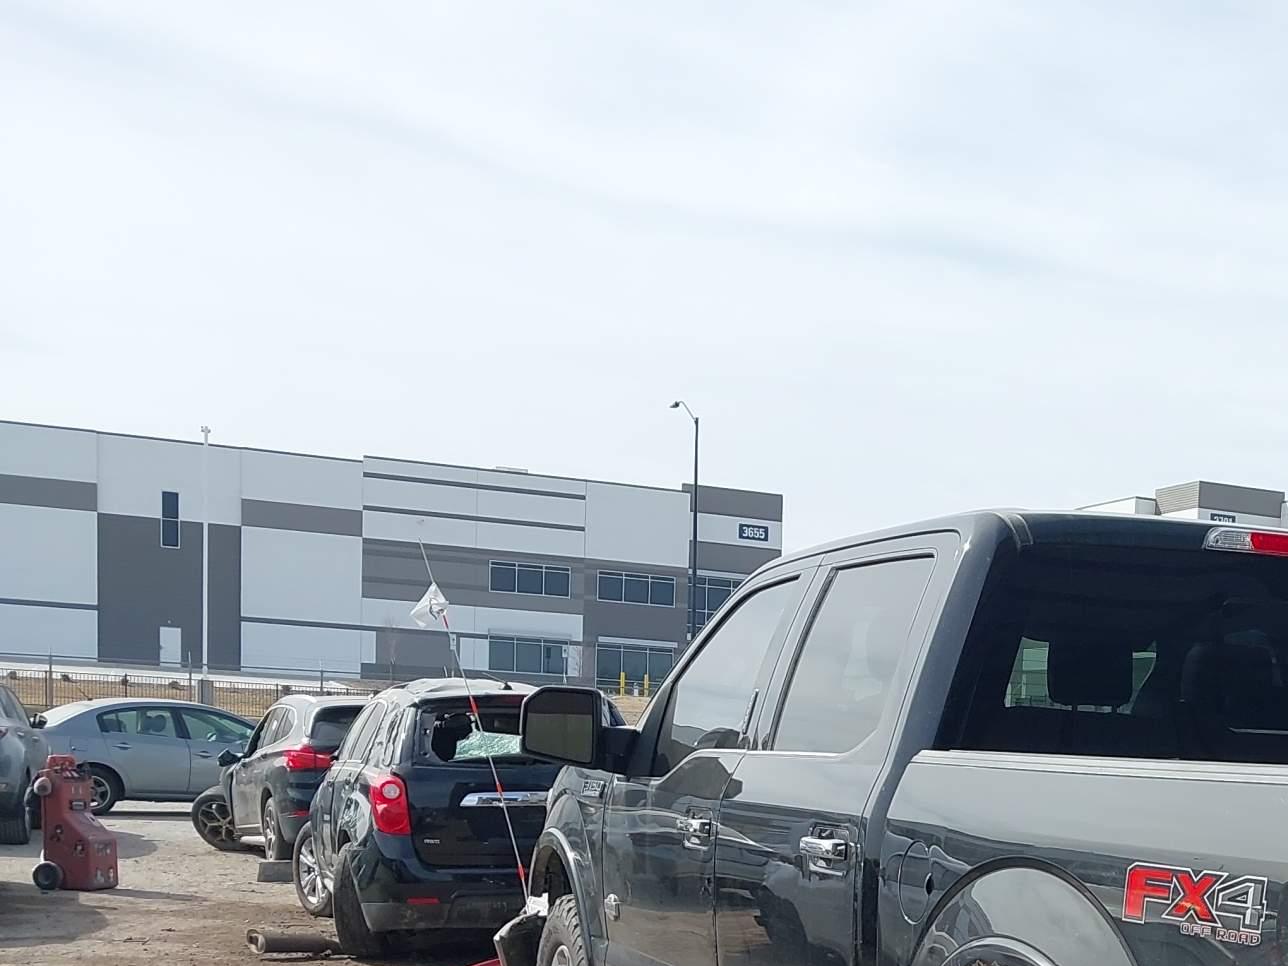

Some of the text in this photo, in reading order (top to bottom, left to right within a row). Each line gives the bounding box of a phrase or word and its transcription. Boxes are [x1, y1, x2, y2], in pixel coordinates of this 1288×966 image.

[742, 526, 766, 539] 3655
[1122, 862, 1268, 934] FX4
[1180, 922, 1262, 946] OFF ROAD
